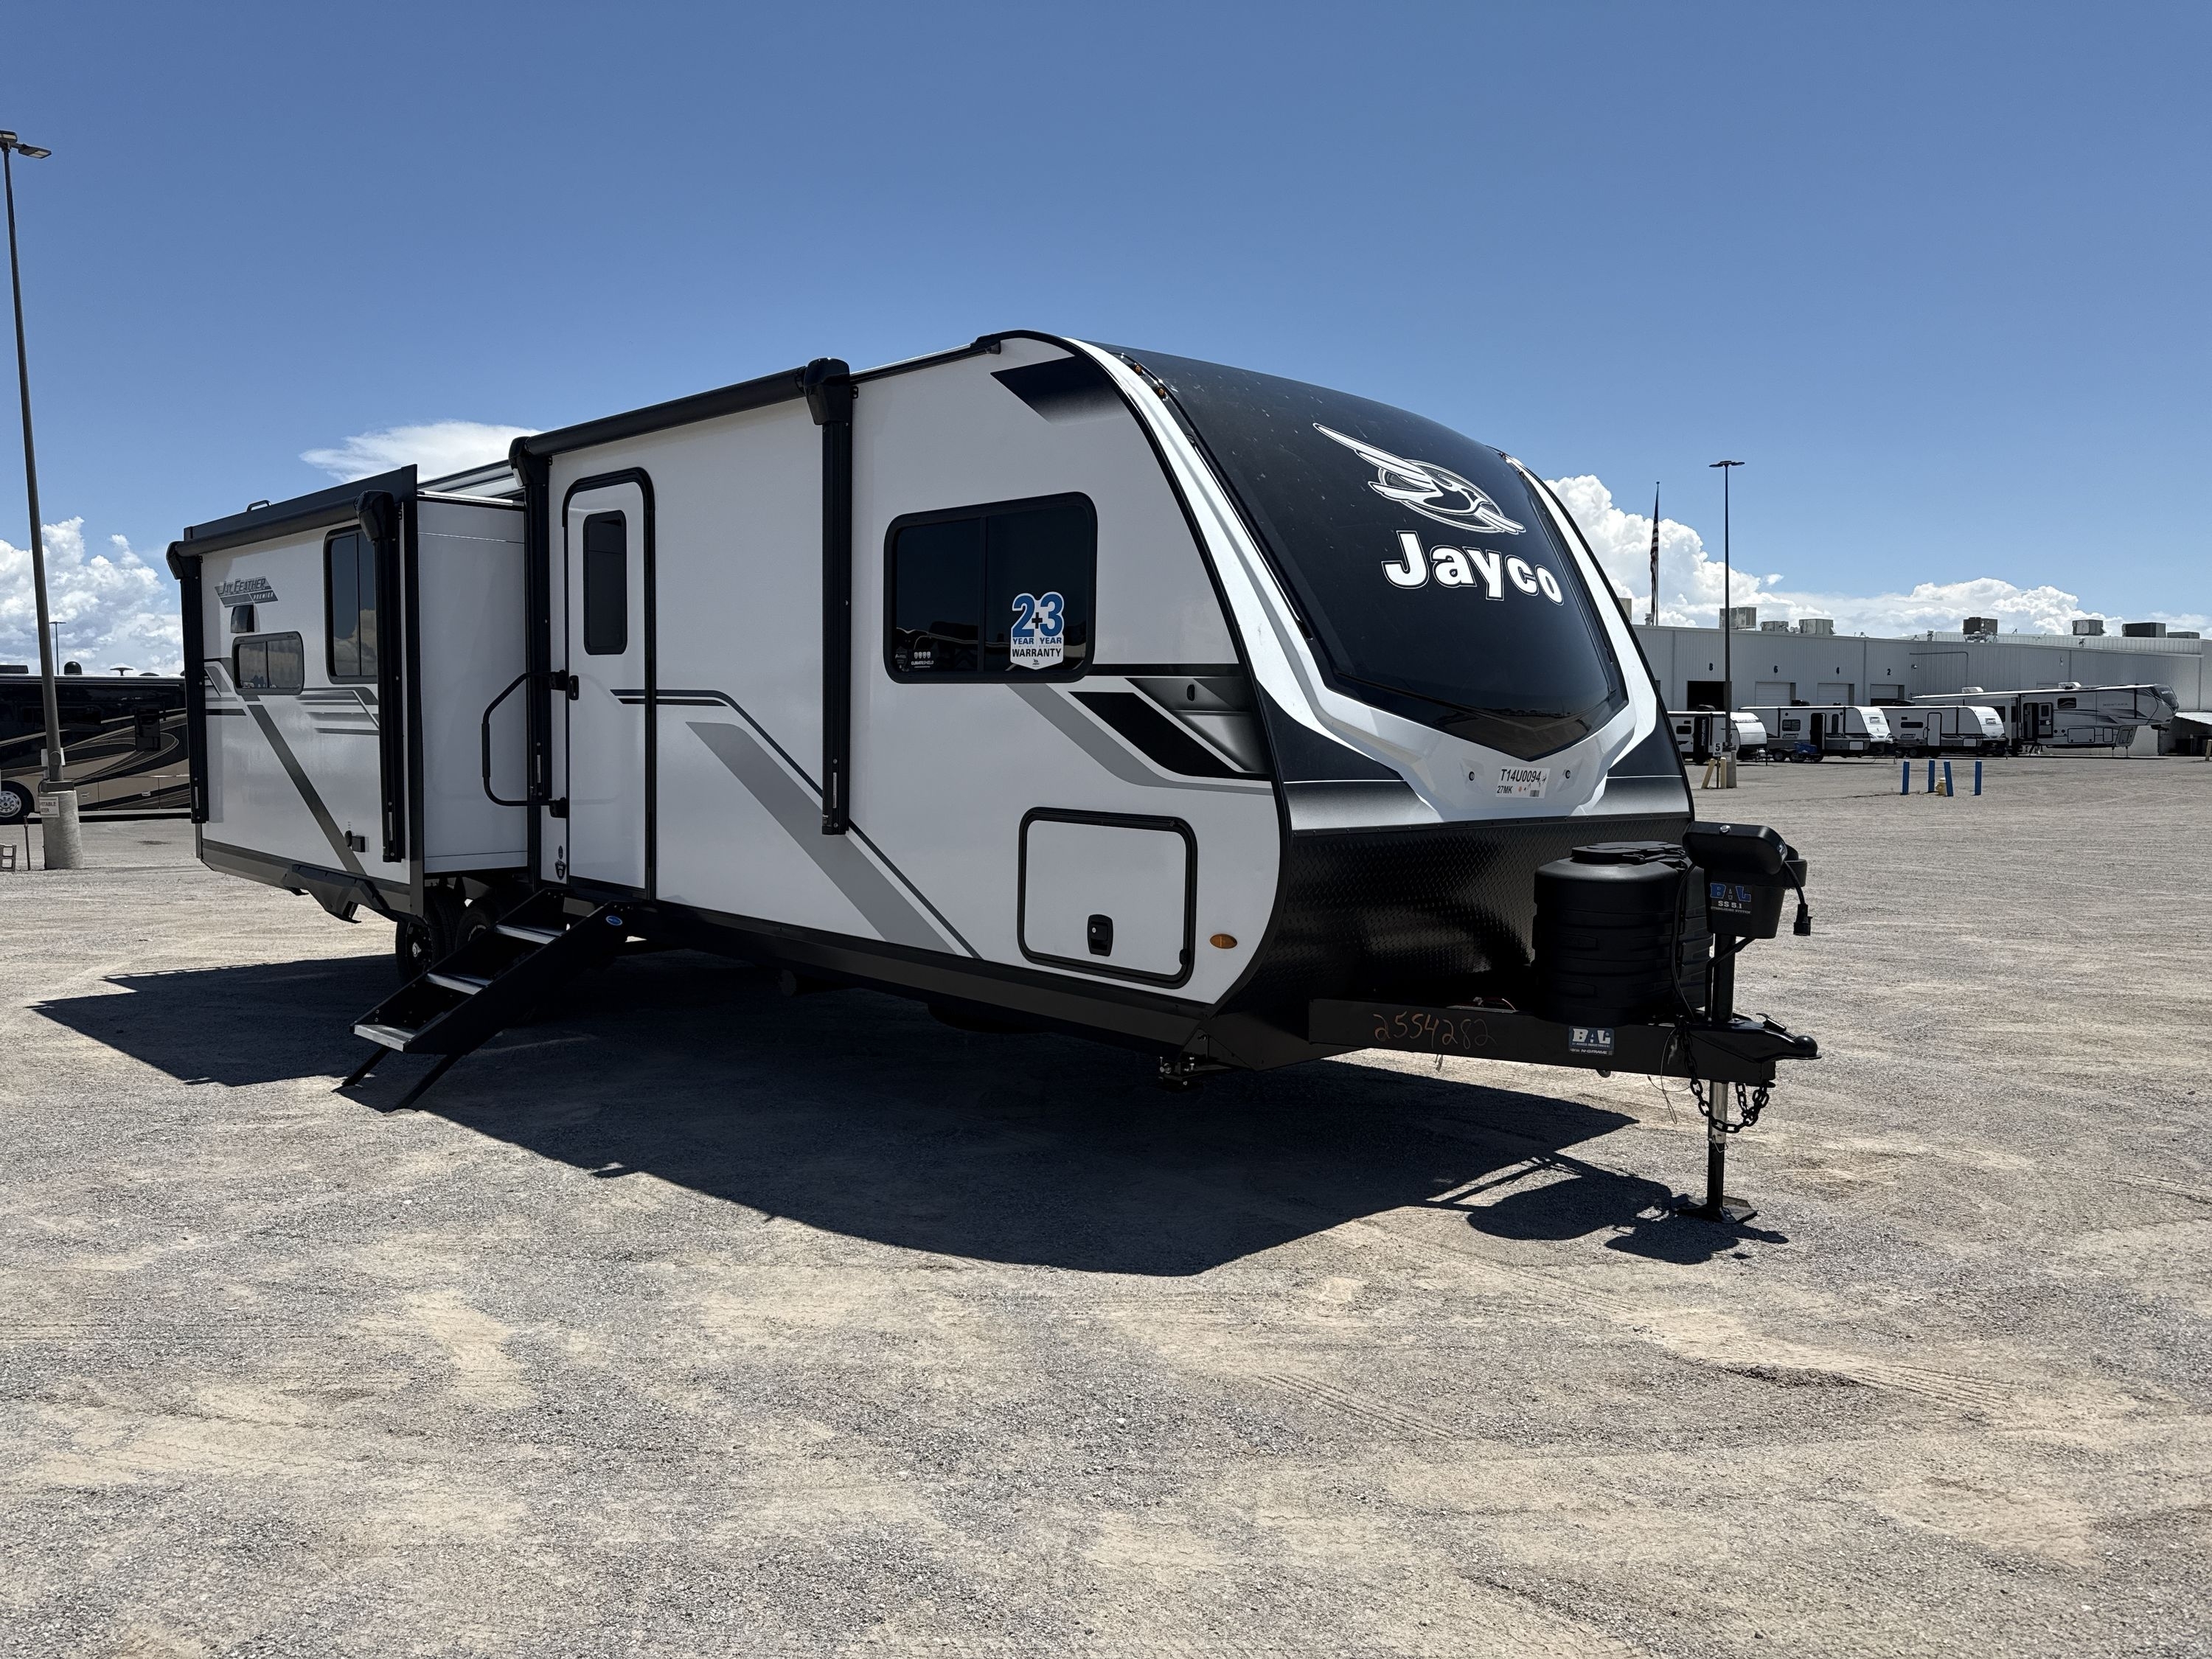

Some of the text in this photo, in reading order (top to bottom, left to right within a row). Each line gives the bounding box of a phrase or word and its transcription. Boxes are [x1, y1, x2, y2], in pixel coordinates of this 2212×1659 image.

[1382, 531, 1564, 605] Jayco
[233, 577, 266, 593] FEATHER
[254, 592, 274, 600] PREMIER
[1012, 648, 1062, 658] WARRANTY
[1708, 663, 1714, 671] 8
[1773, 665, 1778, 673] 6
[1887, 668, 1891, 676] 2
[1715, 742, 1721, 752] 5
[1501, 769, 1542, 783] T14U0094
[1497, 785, 1513, 794] 27MK
[1710, 883, 1752, 902] BAL
[1373, 1011, 1498, 1050] 2554282
[1572, 1028, 1610, 1045] BAL
